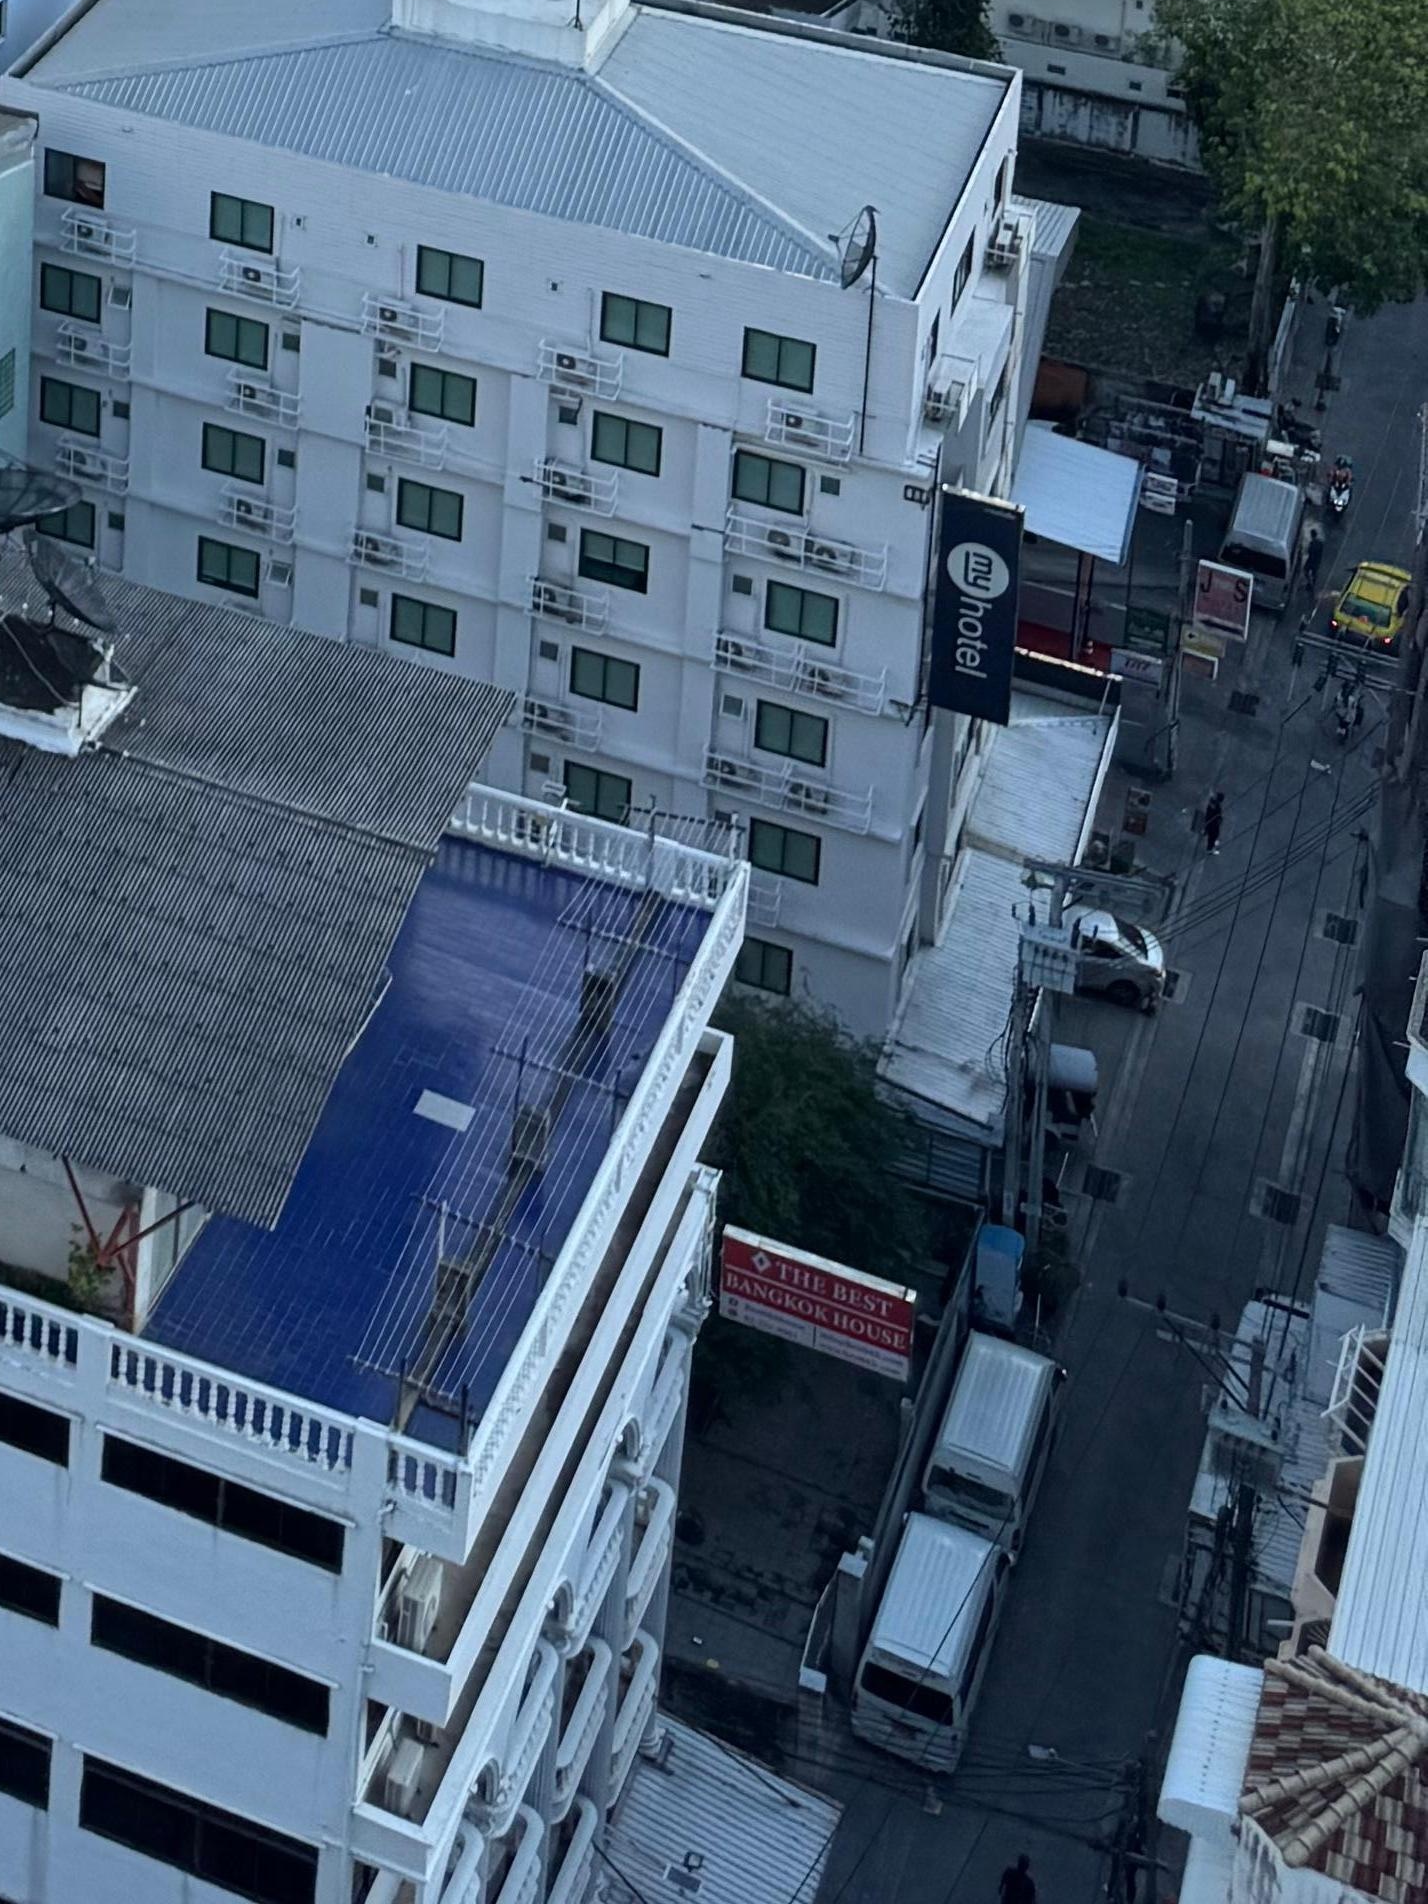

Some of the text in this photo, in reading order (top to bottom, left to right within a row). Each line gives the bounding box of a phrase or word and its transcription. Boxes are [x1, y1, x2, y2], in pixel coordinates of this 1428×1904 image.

[955, 550, 993, 679] my hotel
[725, 1271, 827, 1324] BANGKOK
[834, 1310, 906, 1350] HOUSE
[775, 1261, 826, 1292] THE
[832, 1282, 893, 1317] BEST
